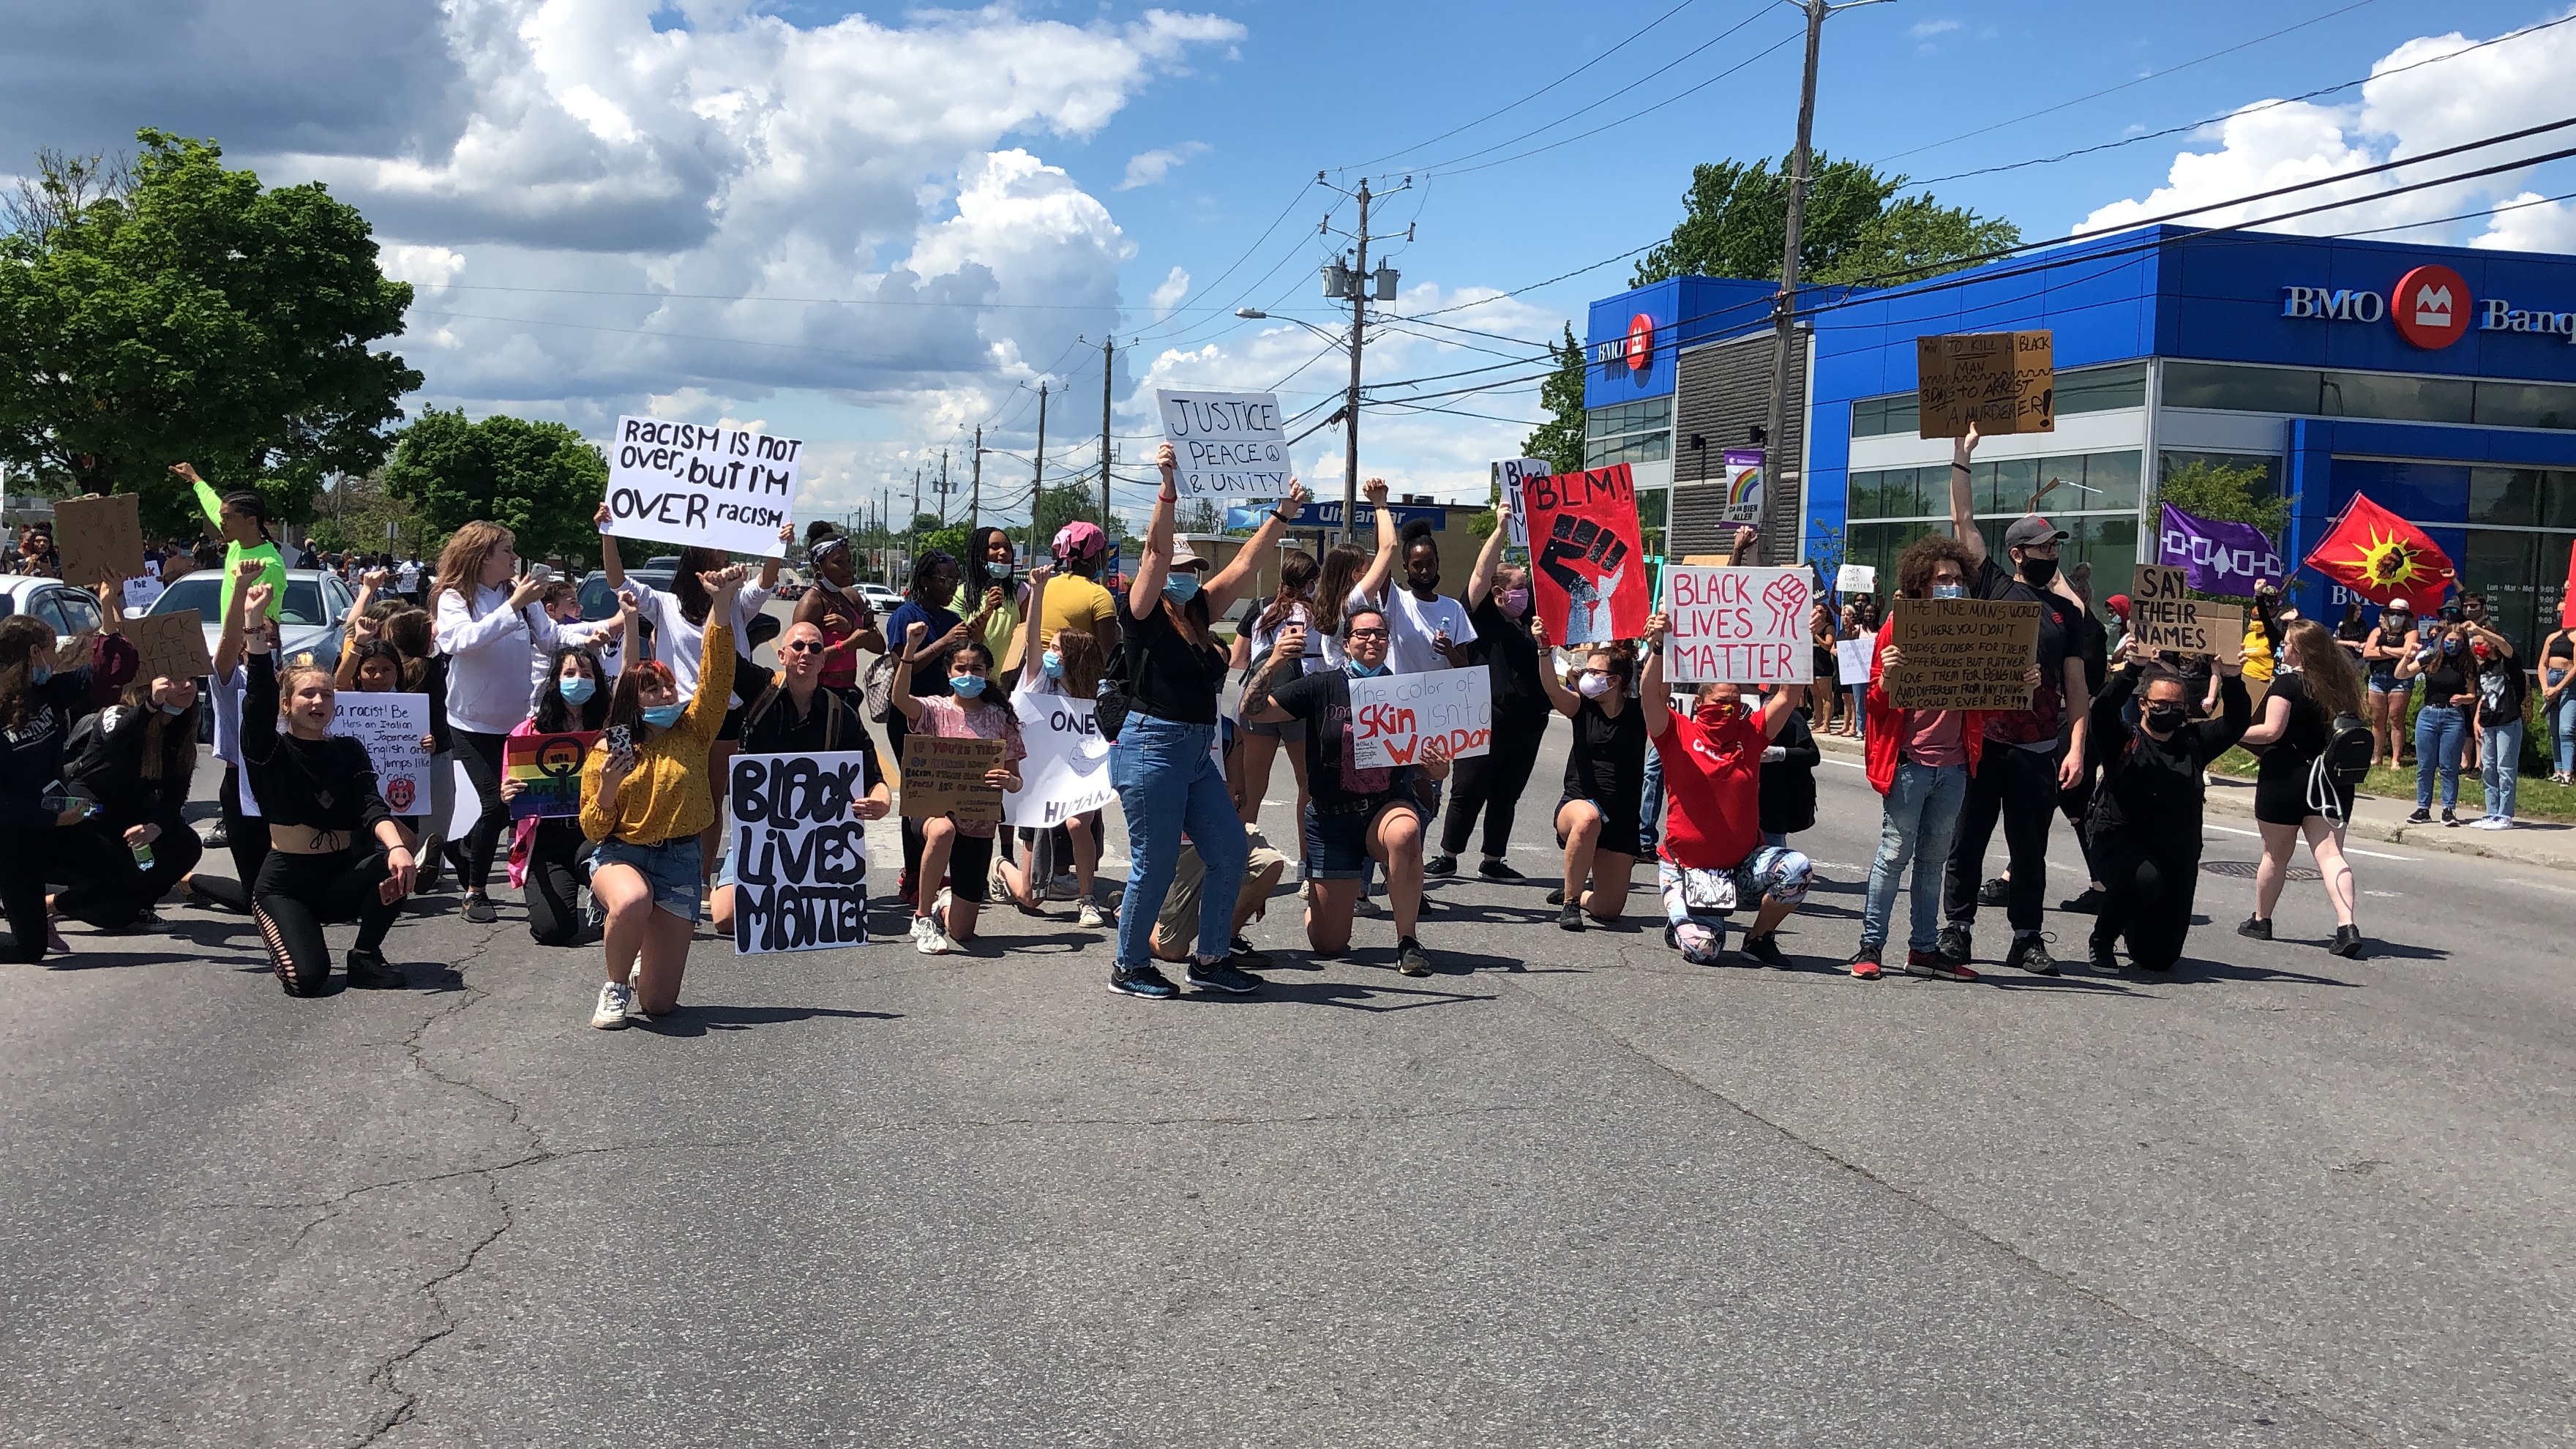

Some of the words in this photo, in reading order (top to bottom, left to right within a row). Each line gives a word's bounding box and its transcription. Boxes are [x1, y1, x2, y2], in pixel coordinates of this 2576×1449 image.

[2281, 285, 2384, 323] BMO
[1598, 340, 1624, 362] BMO
[1971, 340, 1997, 351] KILL
[2019, 335, 2050, 352] BLACK
[1954, 360, 1985, 376] MAN
[1982, 378, 2034, 399] ARREST
[1947, 406, 1958, 429] A
[729, 432, 750, 457] IS
[1188, 441, 1262, 470] PEACE
[748, 463, 789, 496] I'M
[1189, 474, 1205, 493] &
[1527, 464, 1630, 511] BLM!
[611, 487, 709, 530] OVER
[1731, 513, 1753, 521] ALLER
[134, 580, 146, 588] FOR
[1673, 574, 1753, 606] BLACK
[2140, 568, 2184, 600] SAY
[1903, 599, 1931, 615] THE
[1934, 599, 1967, 618] TRUE
[2010, 604, 2040, 618] WORLD
[2133, 600, 2197, 624] THEIR
[1673, 607, 1753, 639] LIVES
[1905, 624, 1917, 639] IS
[1922, 624, 1955, 637] WHERE
[1957, 623, 1976, 634] YOU
[1980, 623, 2017, 637] DON'T
[2134, 624, 2206, 650] NAMES
[1901, 643, 1936, 654] JUDGE
[1939, 643, 1975, 654] OTHERS
[1978, 642, 1999, 653] FOR
[2002, 643, 2029, 656] THEIR
[1674, 643, 1794, 680] MATTER
[1966, 657, 1984, 667] BUT
[1986, 656, 2026, 668] RATHER
[1900, 672, 1925, 684] LOVE
[1932, 670, 1958, 682] THEM
[1963, 669, 1982, 681] FOR
[1352, 681, 1387, 705] The
[1396, 674, 1444, 701] color
[1456, 670, 1477, 692] of
[1961, 684, 1980, 694] FROM
[335, 704, 345, 716] a
[350, 704, 387, 717] racist!
[391, 705, 409, 719] Be
[1917, 697, 1948, 708] COULD
[1955, 697, 1987, 707] EVER
[380, 719, 413, 729] Italian
[1050, 711, 1096, 735] ONE
[372, 730, 418, 742] Japanese
[367, 743, 405, 758] English
[913, 741, 925, 753] IF
[932, 742, 971, 755] YOU'RE
[976, 745, 1003, 755] TIRED
[378, 758, 413, 775] jumps
[415, 757, 430, 768] like
[911, 757, 926, 767] OF
[386, 773, 416, 782] coins
[938, 782, 954, 791] ARE
[733, 757, 861, 830] BLACK
[735, 884, 869, 953] MATTER
